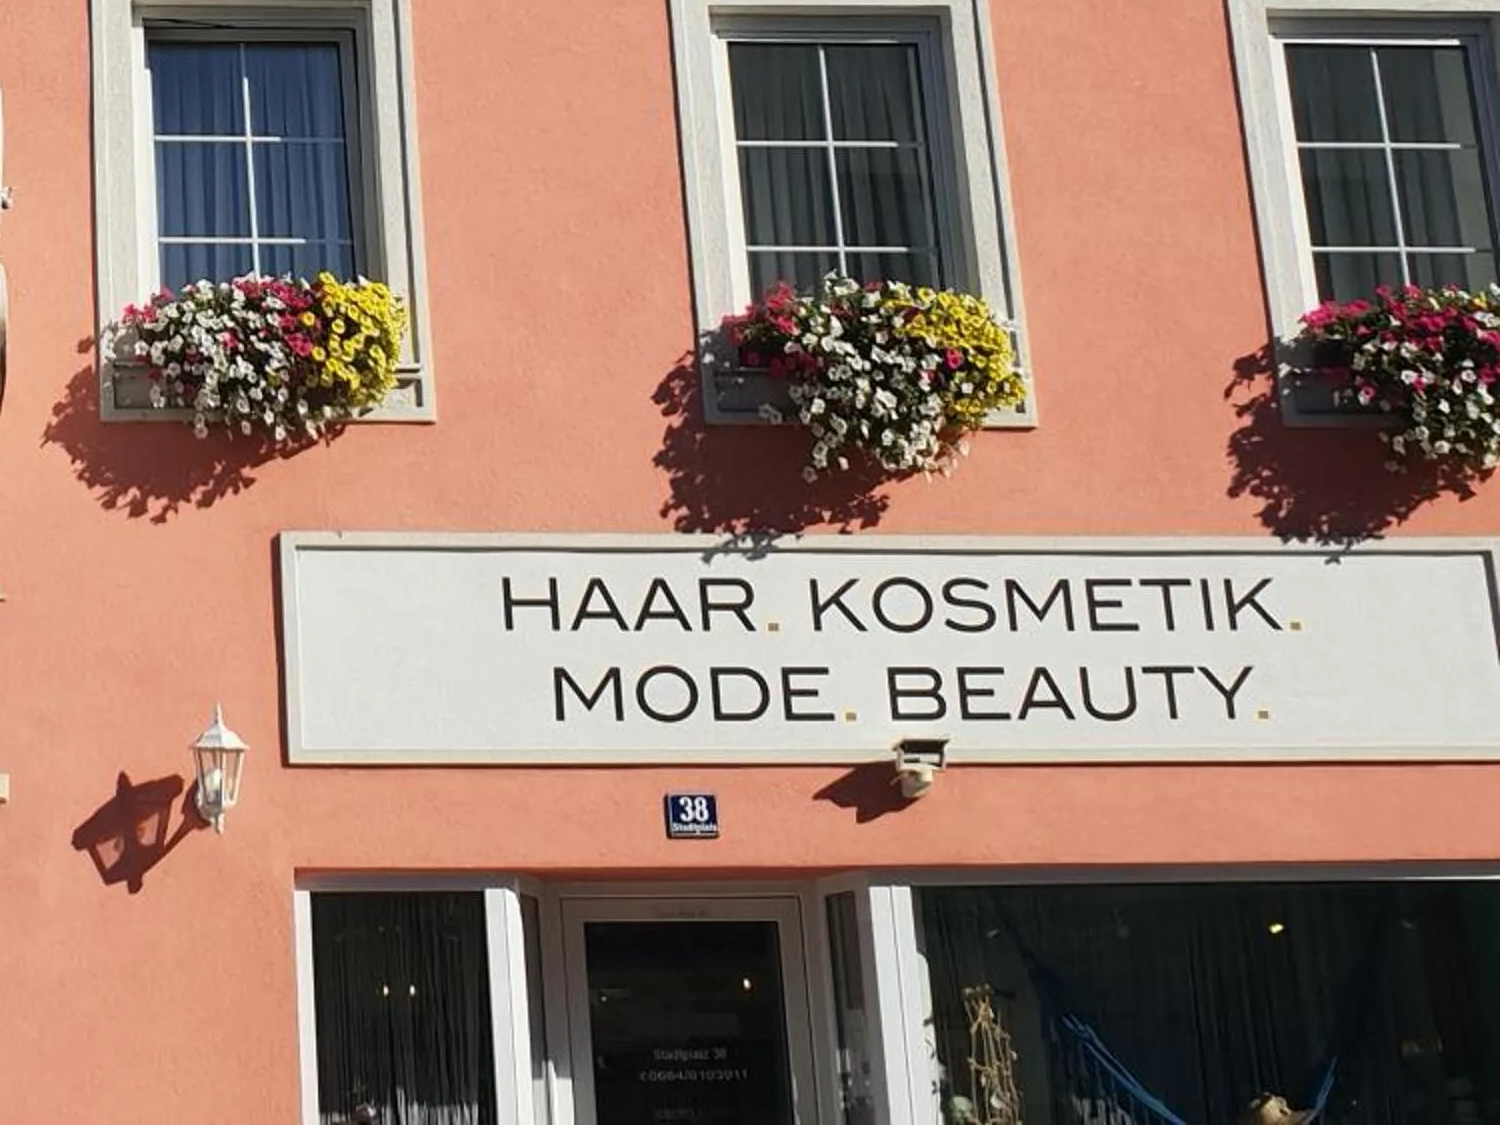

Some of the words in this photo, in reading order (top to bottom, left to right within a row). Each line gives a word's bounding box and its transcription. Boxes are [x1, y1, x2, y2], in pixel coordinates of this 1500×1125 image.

[502, 577, 781, 632] HAAR.
[809, 577, 1302, 634] KOSMETIK.
[554, 665, 857, 723] MODE.
[887, 666, 1269, 722] BEAUTY.
[679, 796, 709, 822] 38
